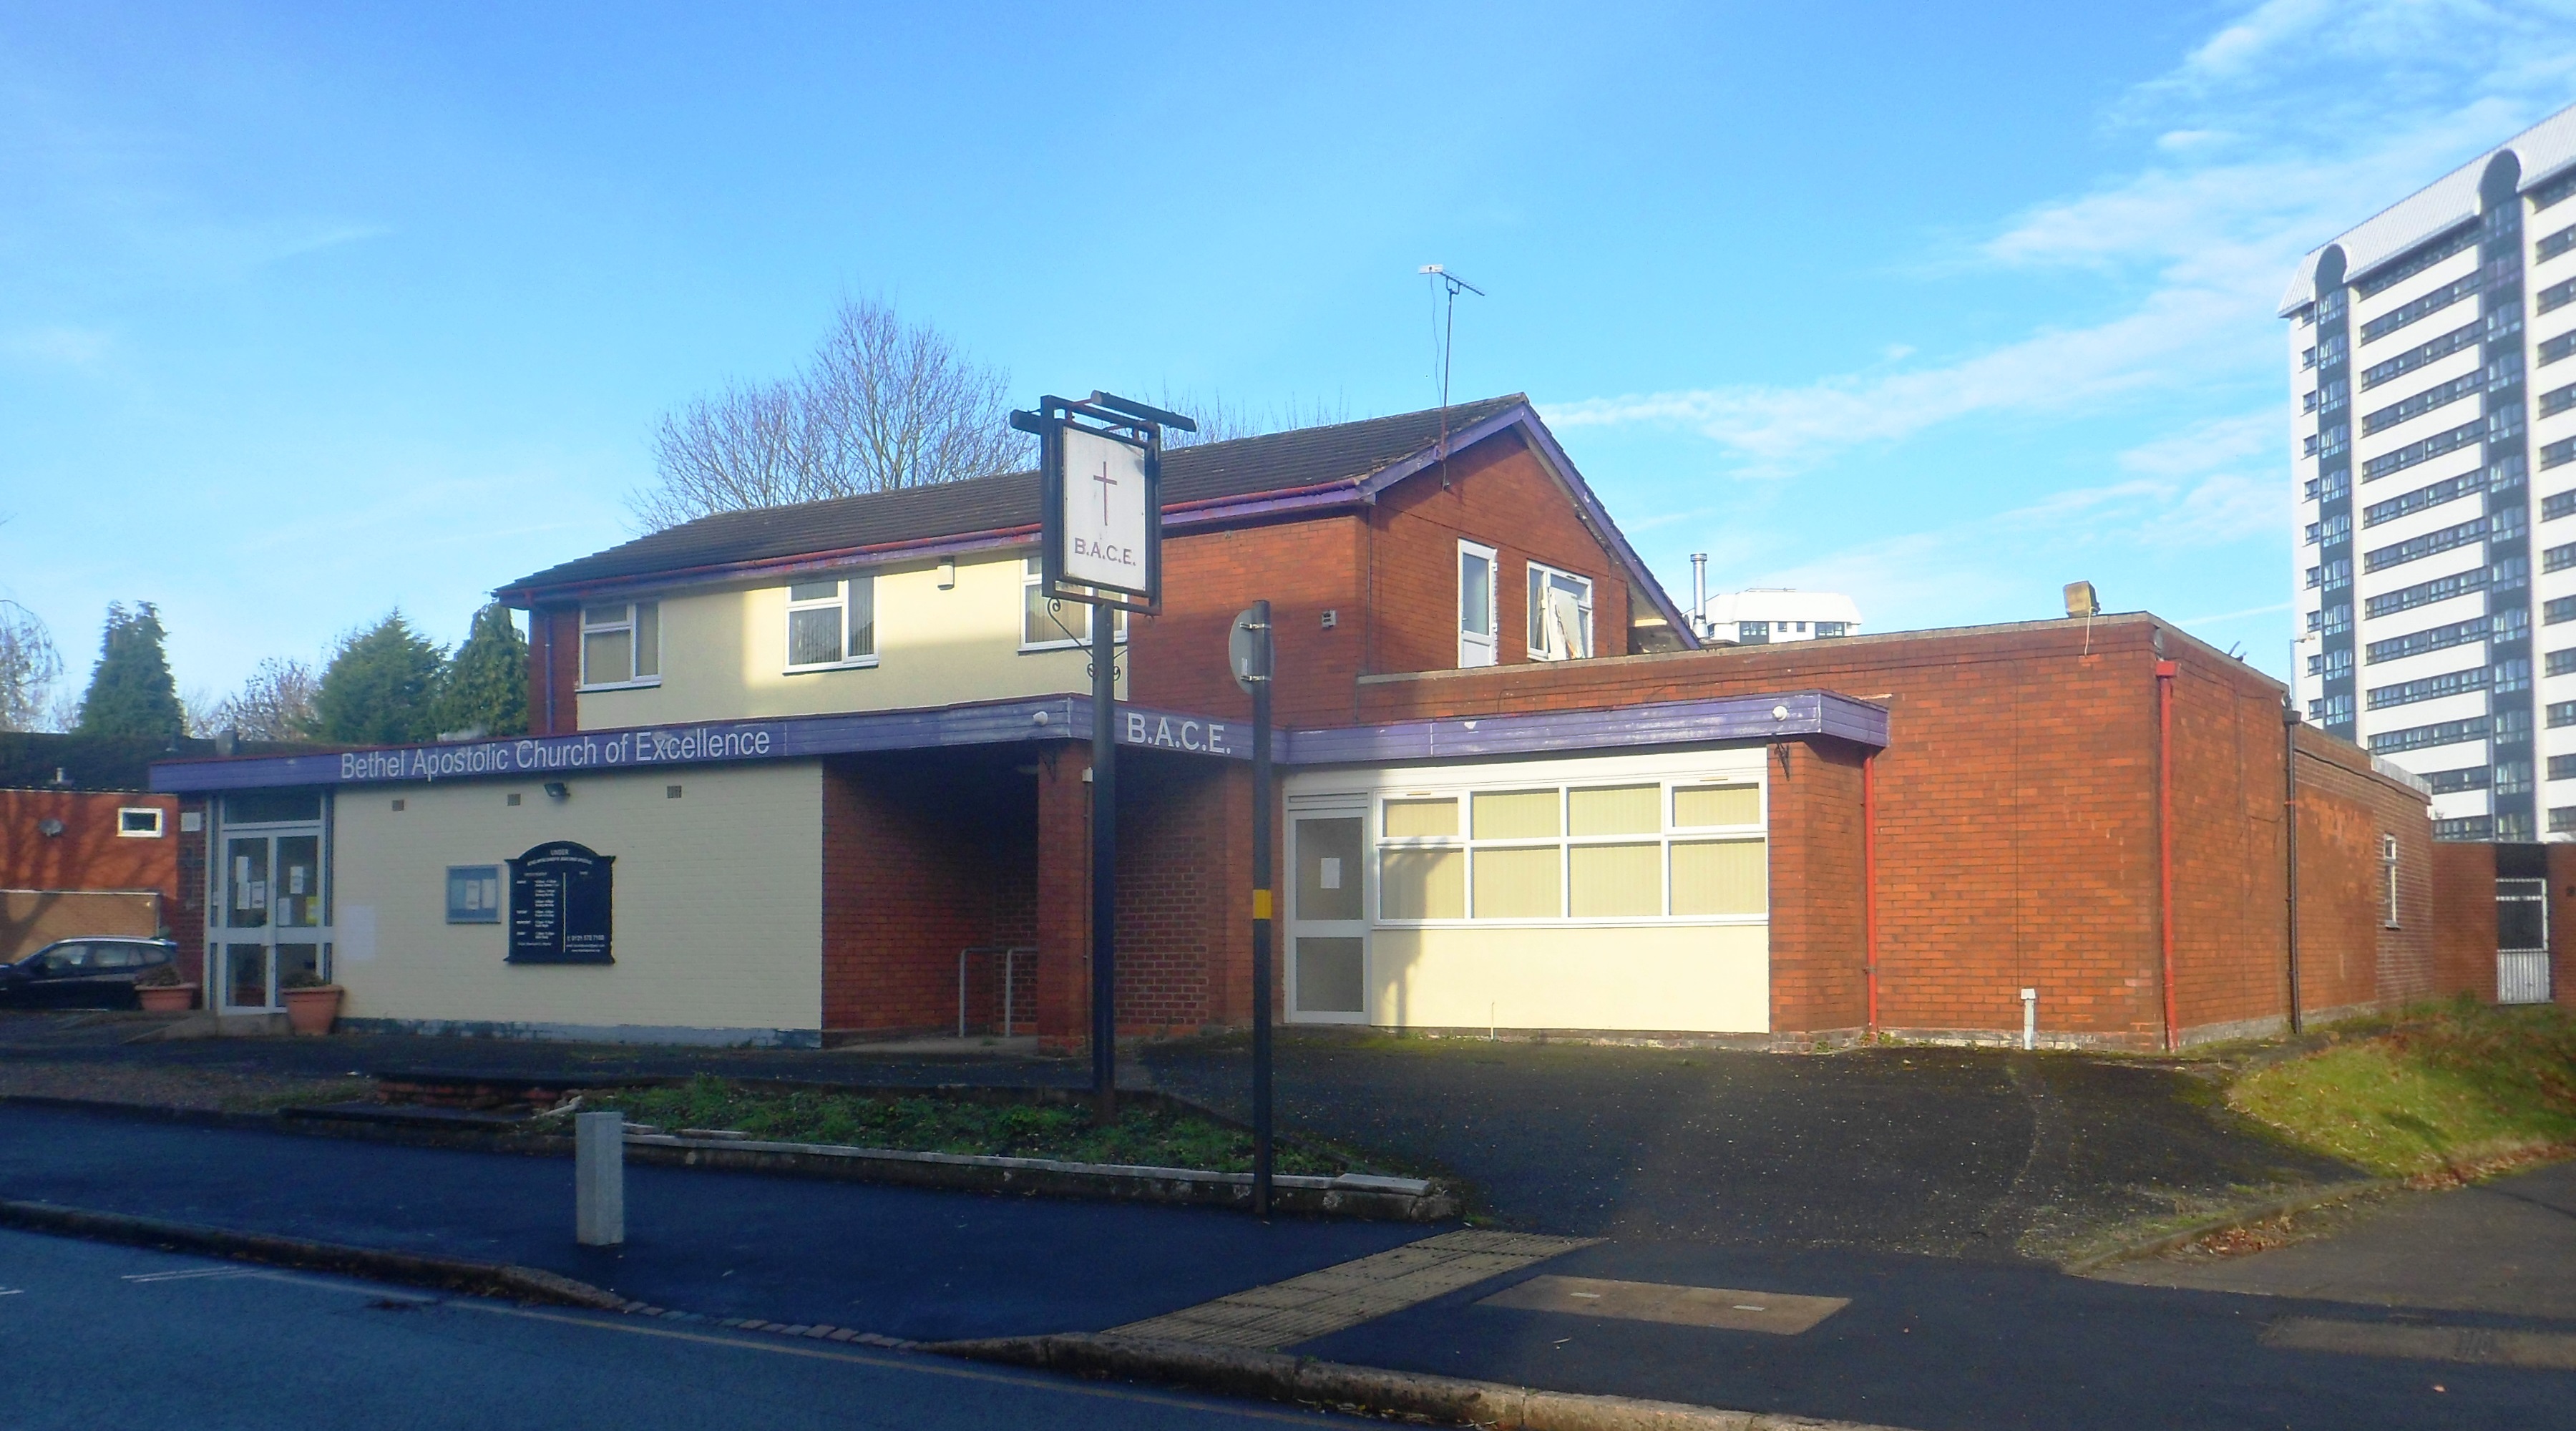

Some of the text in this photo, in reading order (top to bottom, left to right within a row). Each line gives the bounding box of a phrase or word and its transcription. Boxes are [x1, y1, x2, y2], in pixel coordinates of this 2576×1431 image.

[1075, 537, 1136, 566] B.A.C.E.
[1127, 712, 1231, 754] B.A.C.E.
[341, 728, 770, 781] Bethel Apostolic Church of Excellence
